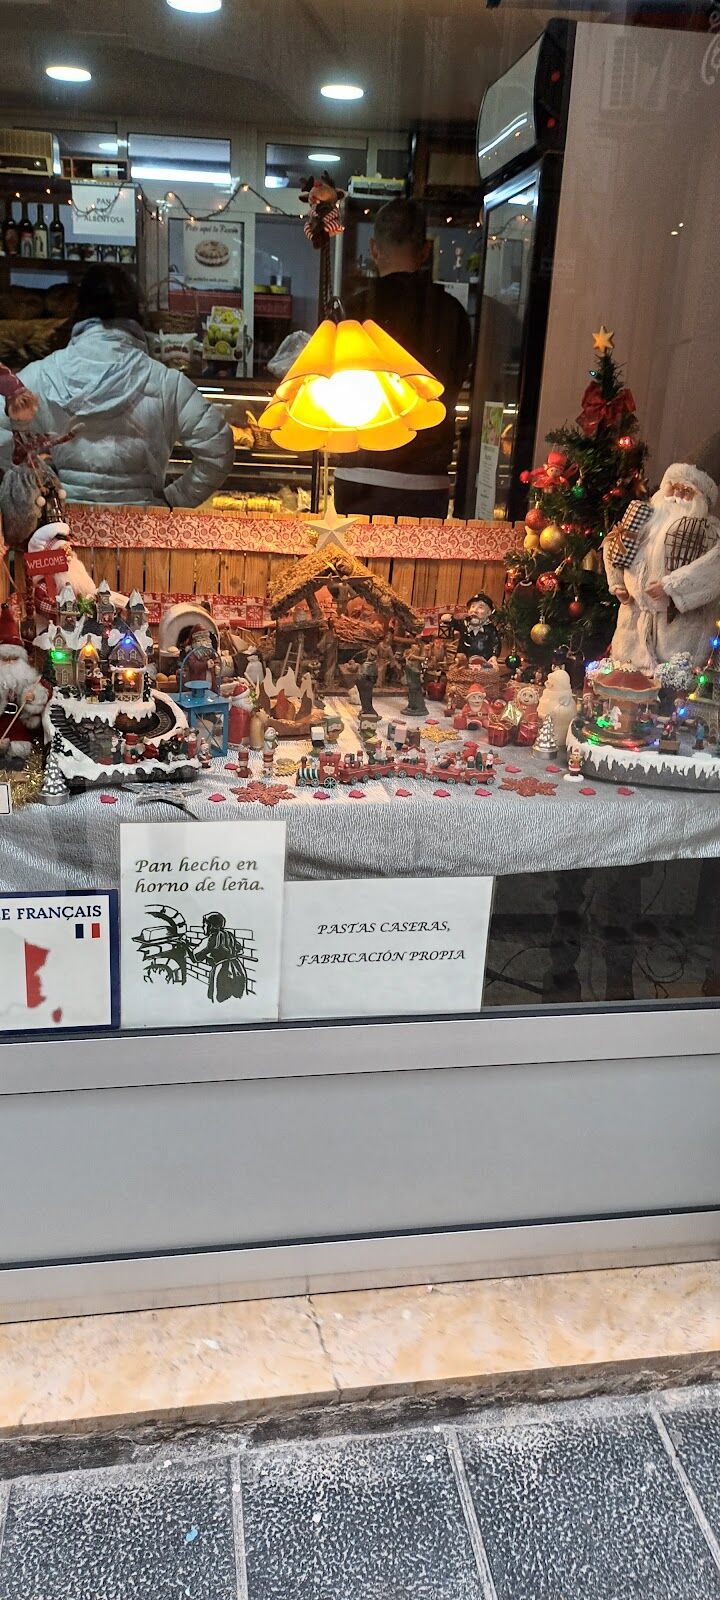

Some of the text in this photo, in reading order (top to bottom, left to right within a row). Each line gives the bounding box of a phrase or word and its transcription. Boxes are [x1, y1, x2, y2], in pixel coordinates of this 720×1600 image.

[26, 556, 65, 569] WELCOME
[135, 856, 258, 873] Pan hecho en
[135, 876, 264, 893] horno de leña.
[17, 905, 102, 920] FRANÇAIS
[317, 921, 451, 934] PASTAS CASERAS,
[297, 950, 466, 967] FABRICACIÓN PROPIA
